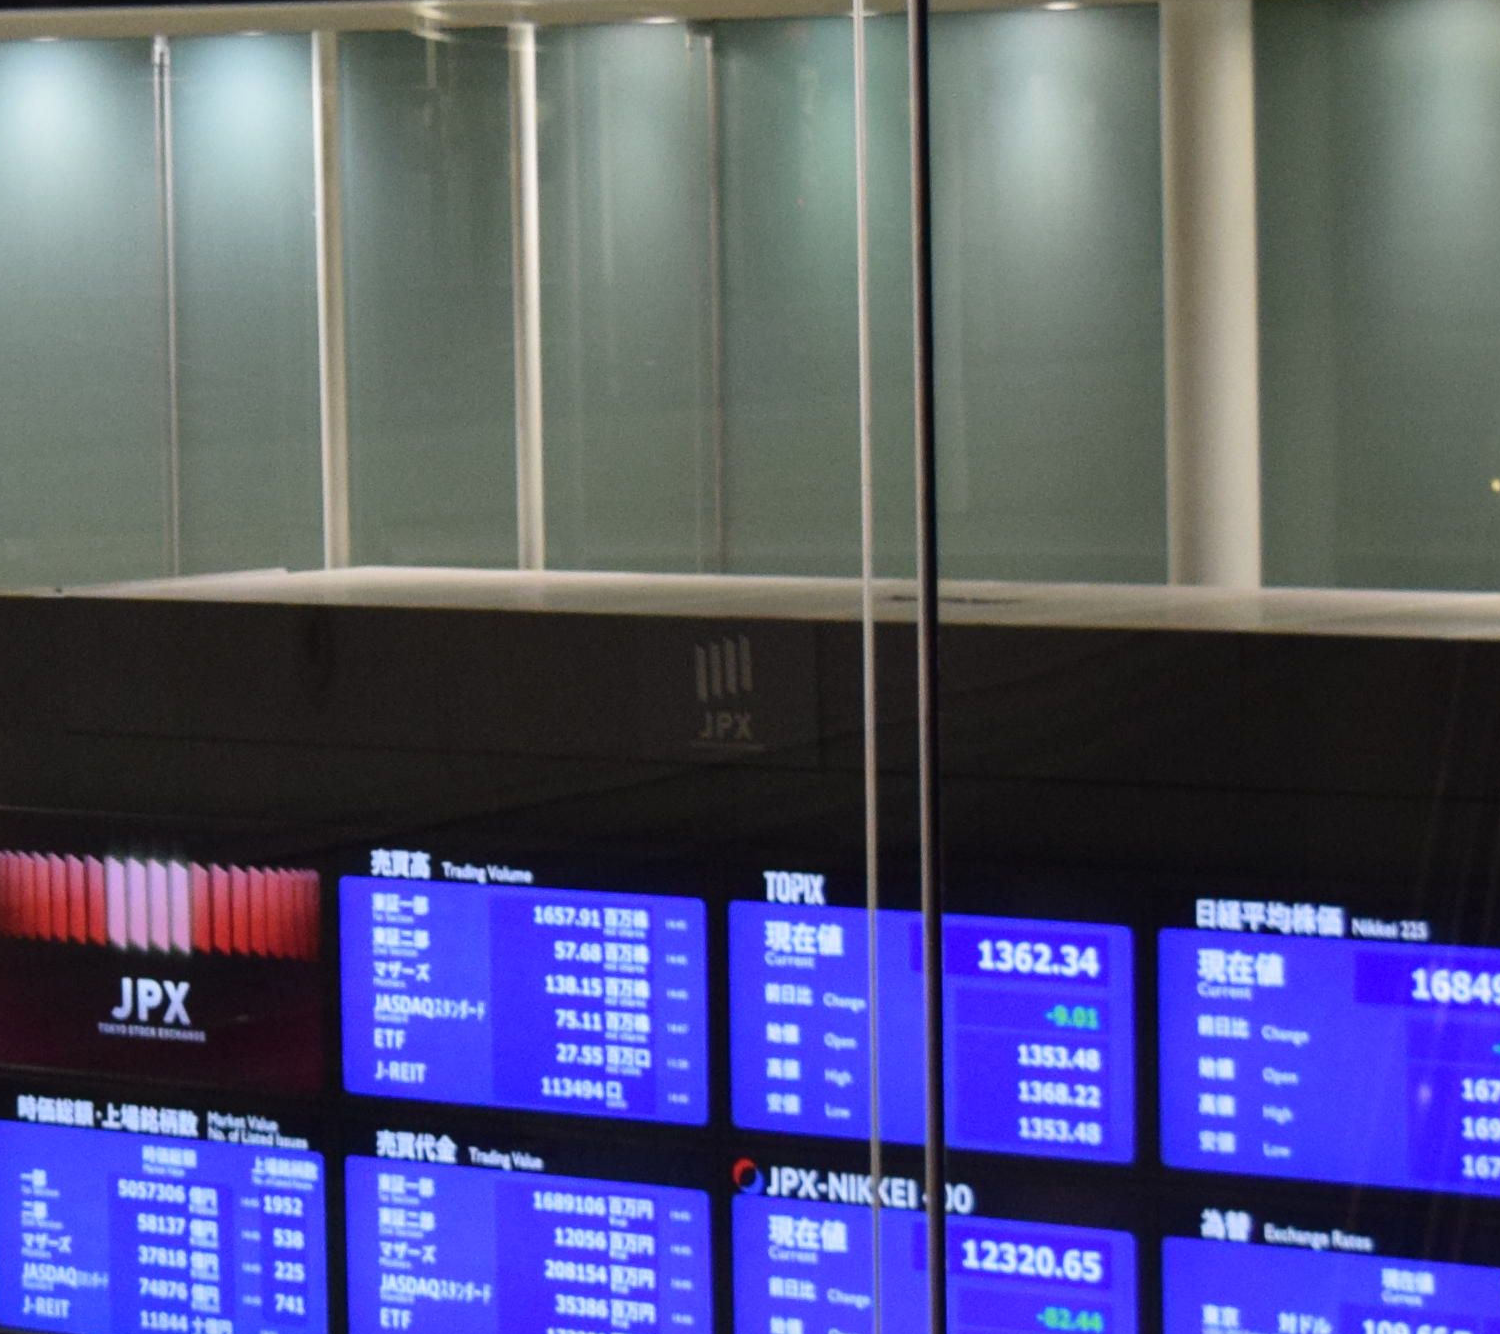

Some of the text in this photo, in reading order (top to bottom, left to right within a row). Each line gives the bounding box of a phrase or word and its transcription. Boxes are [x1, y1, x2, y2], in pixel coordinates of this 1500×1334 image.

[371, 849, 533, 883] 売買高 Trading Volume
[764, 871, 825, 905] TOPIX
[534, 905, 602, 928] 1657.91
[1196, 899, 1344, 938] 日経平均株価
[765, 921, 1100, 979] 現在値 1362.34
[1198, 949, 1284, 987] 現在値
[374, 962, 431, 982] マザーズ
[111, 977, 191, 1025] JPX
[374, 1028, 405, 1049] ETF
[375, 1060, 427, 1083] J-REIT
[376, 1130, 544, 1170] 売買代金 Trading Value
[766, 1166, 918, 1209] JPX-NIKKEI
[263, 1195, 303, 1218] 1952
[1201, 1208, 1251, 1243] 為替
[1264, 1222, 1330, 1251] Exchange
[768, 1214, 1102, 1282] 現在値 12320.65
[381, 1307, 411, 1329] ETF
